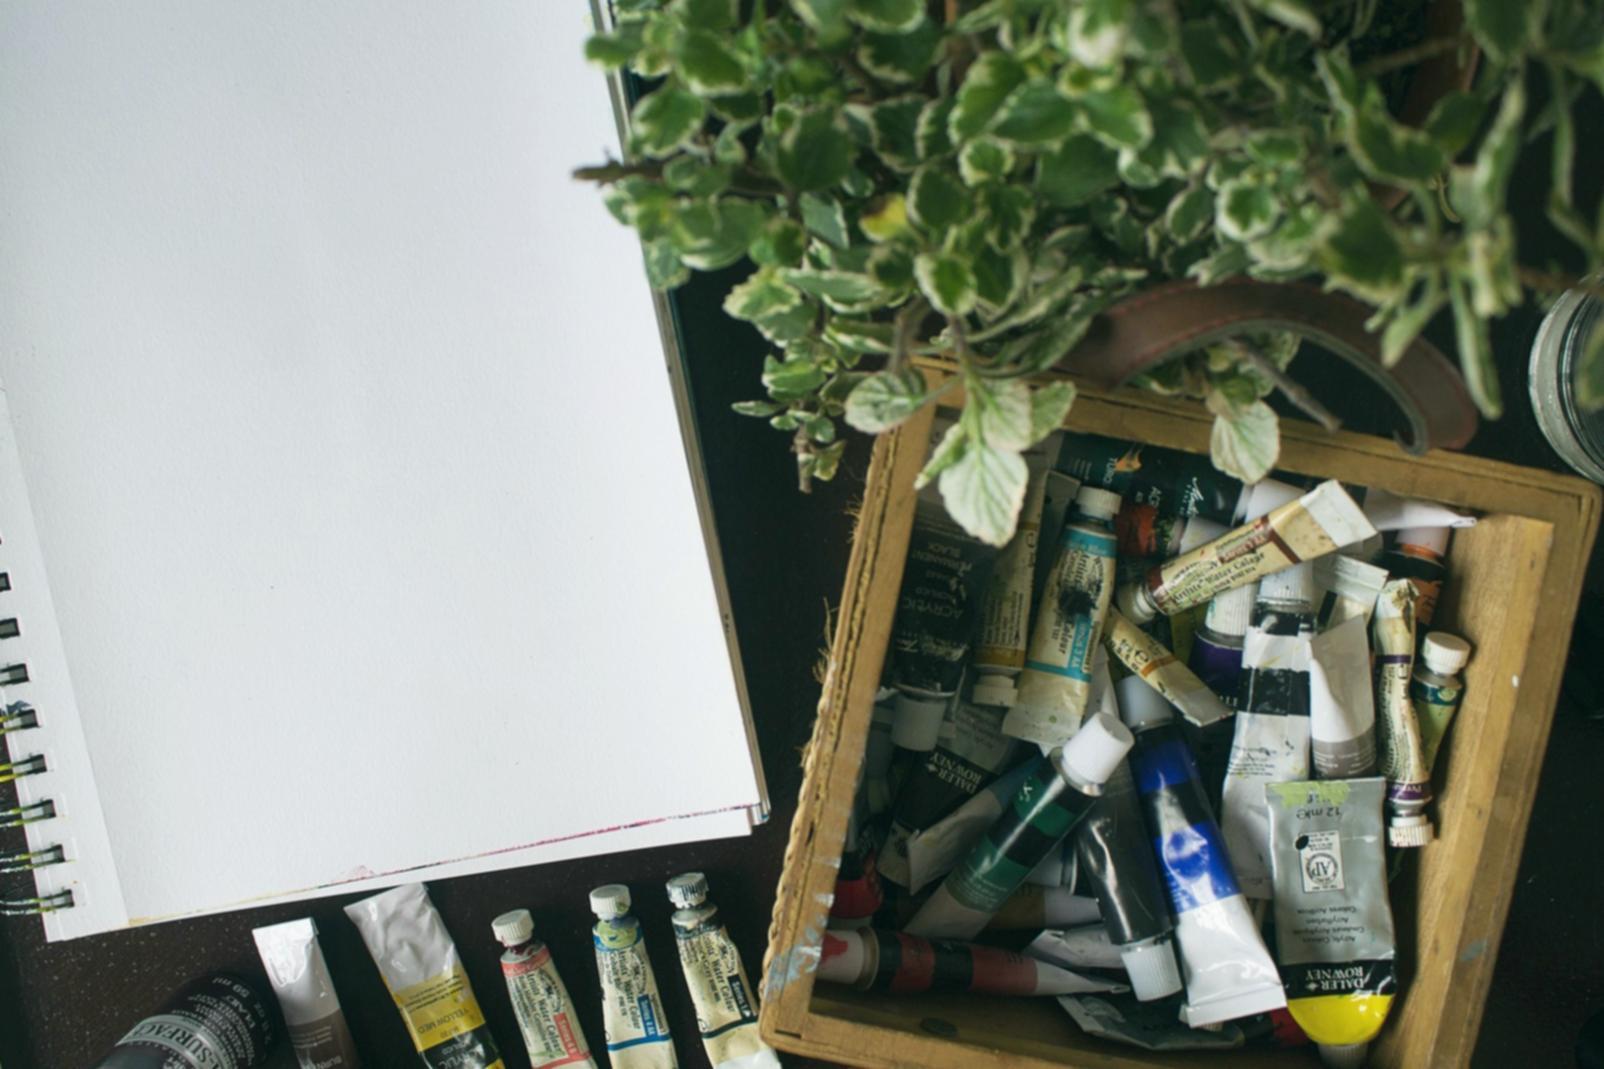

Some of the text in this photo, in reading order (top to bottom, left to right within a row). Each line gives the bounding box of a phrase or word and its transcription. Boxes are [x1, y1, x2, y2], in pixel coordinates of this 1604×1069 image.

[929, 750, 982, 785] ROWNEY
[936, 767, 978, 794] DALER
[1311, 860, 1330, 875] AP
[1305, 966, 1363, 980] ROWNEY
[1321, 977, 1364, 990] DALER
[624, 980, 635, 1004] Water
[711, 959, 726, 984] Water
[719, 984, 736, 1013] Colour
[436, 1007, 468, 1025] YELLOW
[628, 1005, 641, 1029] Colour
[640, 999, 652, 1020] Series
[536, 997, 553, 1024] Water
[545, 1023, 564, 1053] Colour
[557, 1017, 573, 1041] Series
